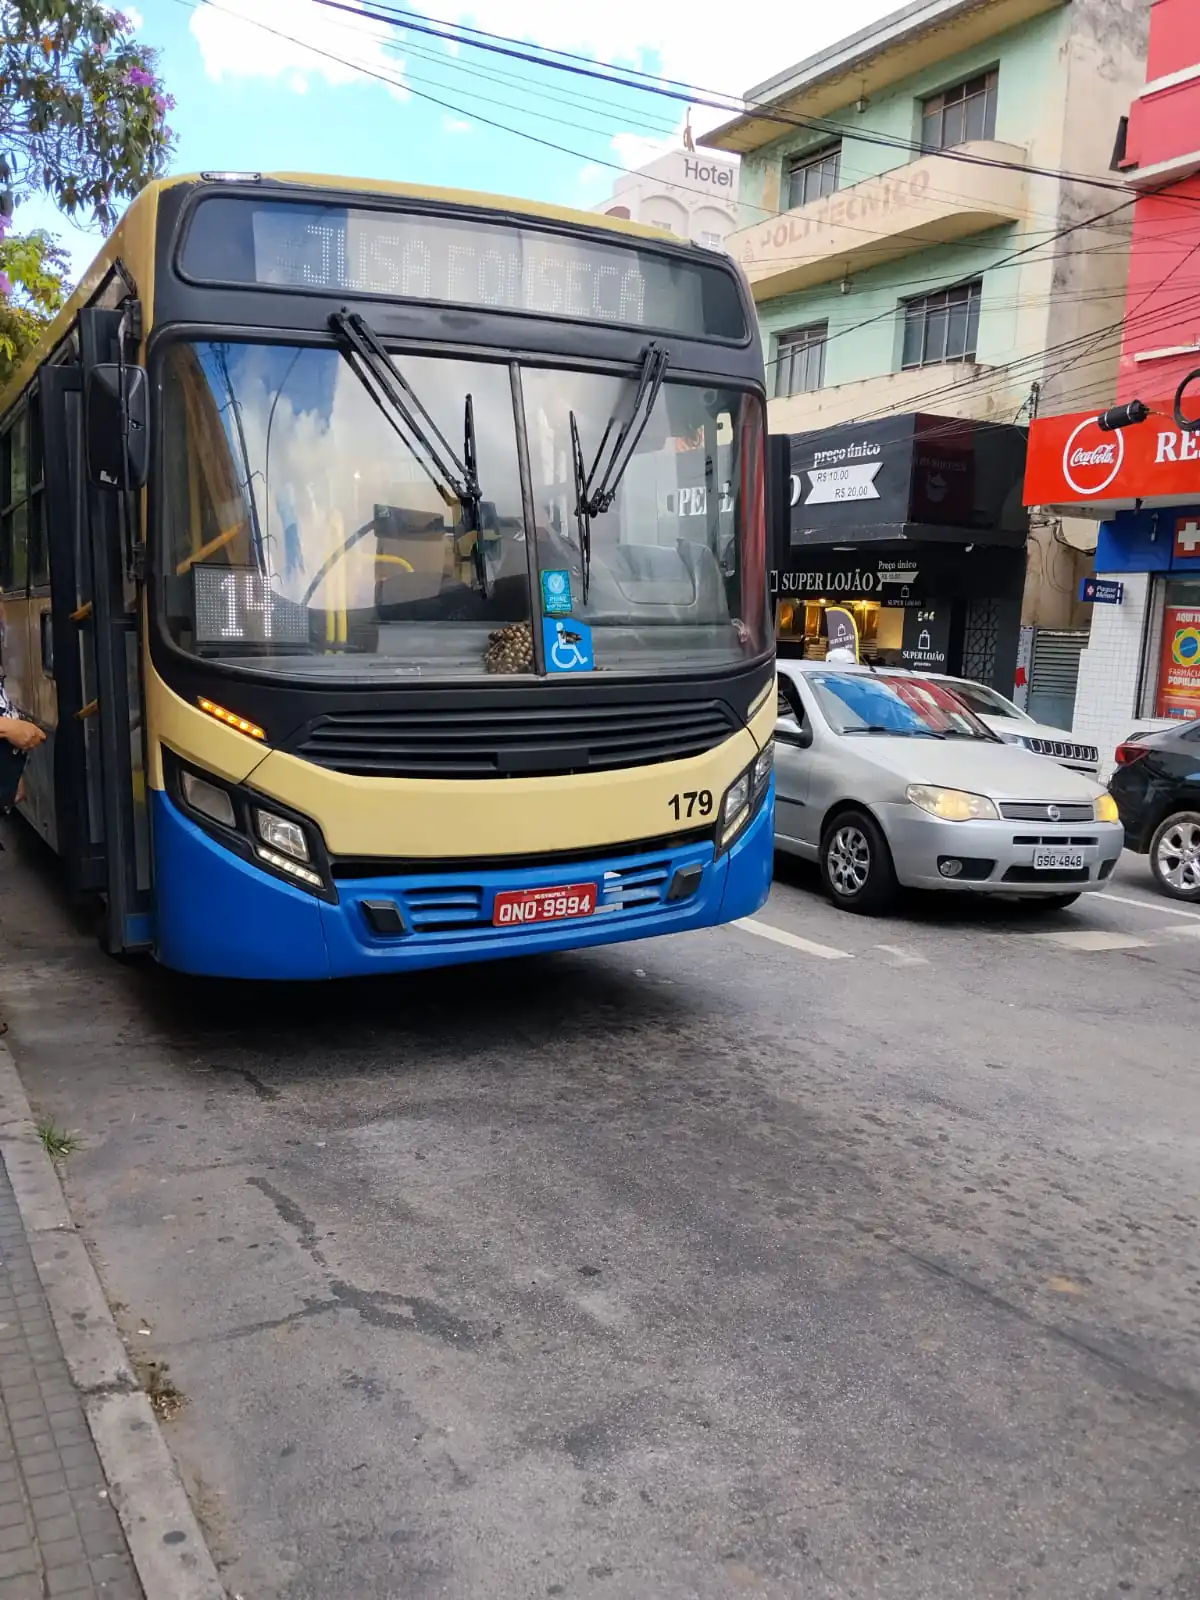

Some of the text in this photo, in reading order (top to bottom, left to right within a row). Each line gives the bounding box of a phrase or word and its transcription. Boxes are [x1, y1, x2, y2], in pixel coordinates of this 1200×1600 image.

[684, 158, 734, 188] Hotel
[303, 223, 647, 323] JUSA FONSECA
[1154, 429, 1200, 463] RE
[835, 488, 845, 498] R$
[781, 569, 874, 592] SUPER LOJÃO
[220, 574, 275, 637] 14
[902, 650, 923, 660] SUPER
[668, 789, 713, 820] 179
